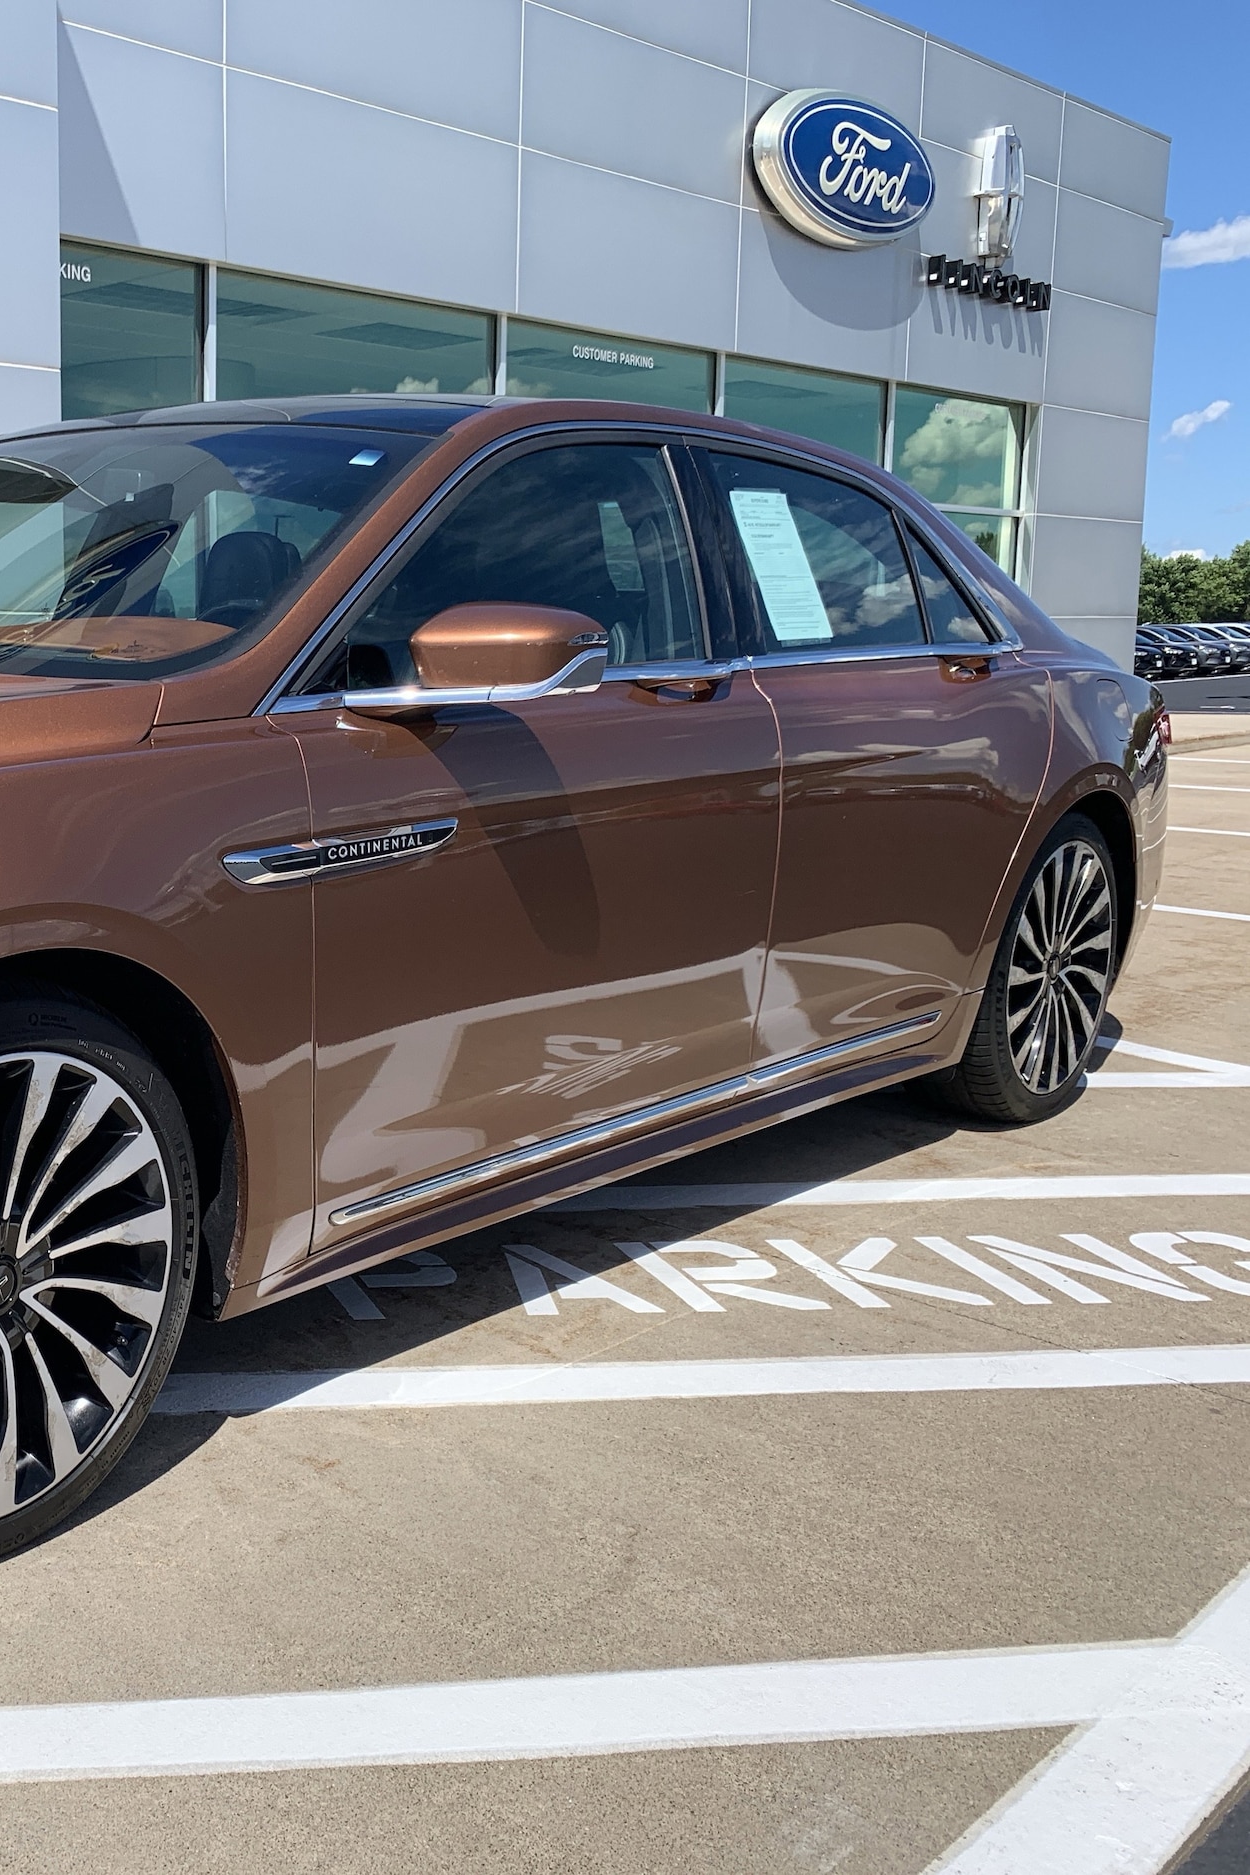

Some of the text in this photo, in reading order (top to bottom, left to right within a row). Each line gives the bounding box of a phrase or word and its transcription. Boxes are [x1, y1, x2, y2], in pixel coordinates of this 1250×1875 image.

[819, 121, 911, 214] Ford
[60, 263, 91, 282] KING
[573, 345, 654, 369] CUSTOMER PARKING
[327, 833, 423, 860] CONTINENTAL
